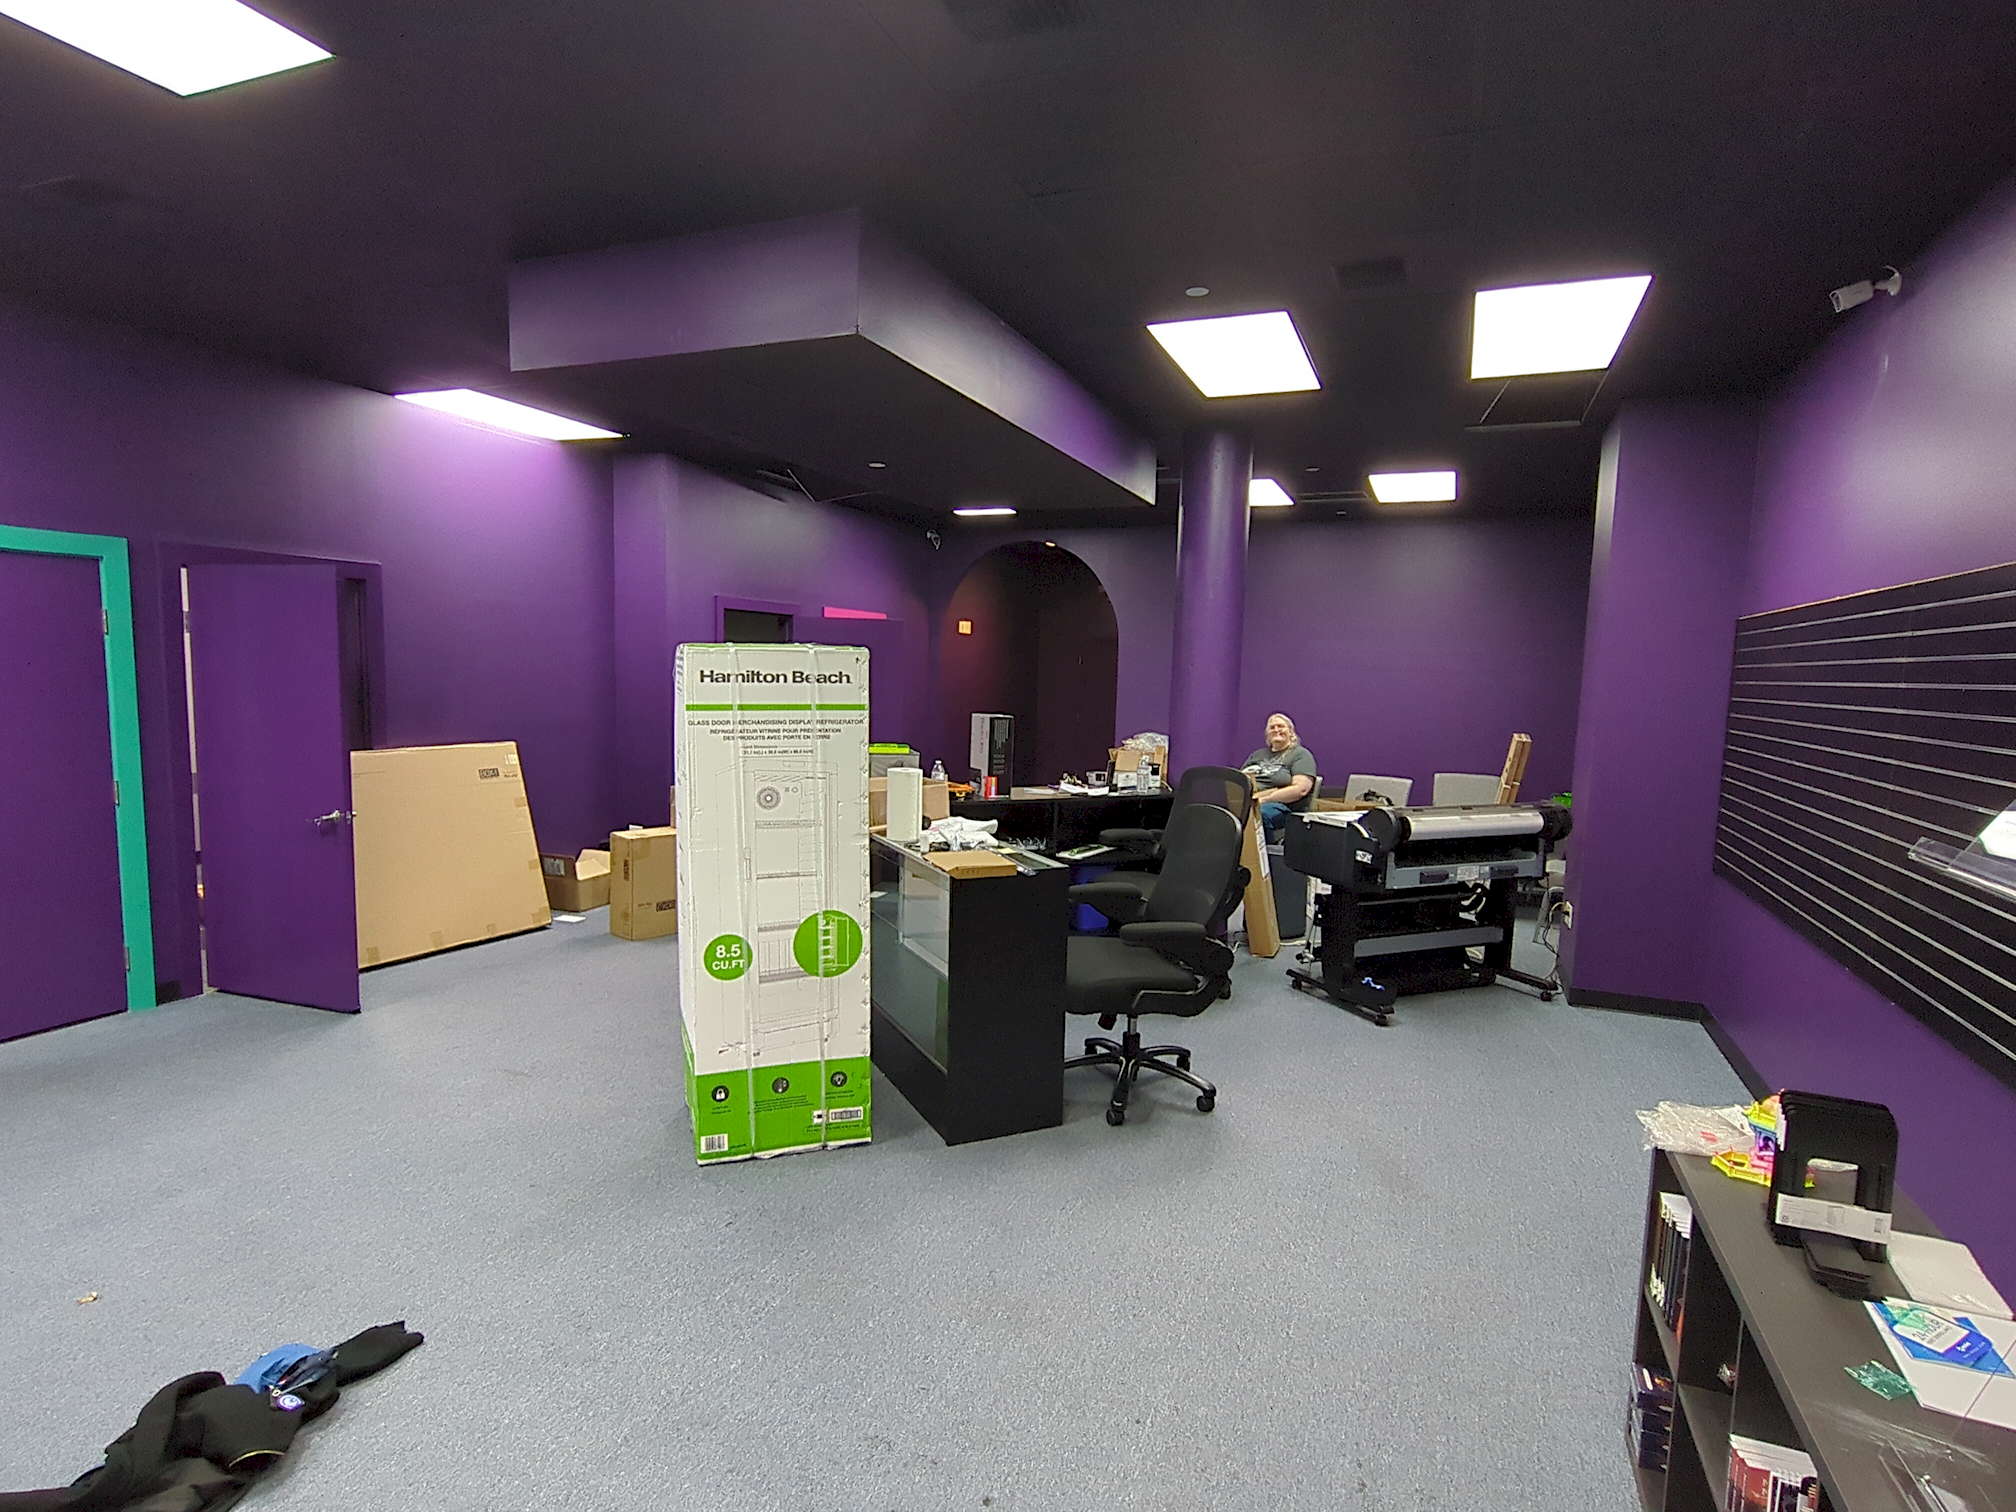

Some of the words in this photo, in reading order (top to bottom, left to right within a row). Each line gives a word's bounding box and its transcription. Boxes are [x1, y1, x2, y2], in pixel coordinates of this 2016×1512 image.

[699, 669, 788, 684] Hamilton
[791, 670, 851, 685] Beach
[715, 943, 741, 958] 8.5
[711, 959, 746, 970] CU.FT
